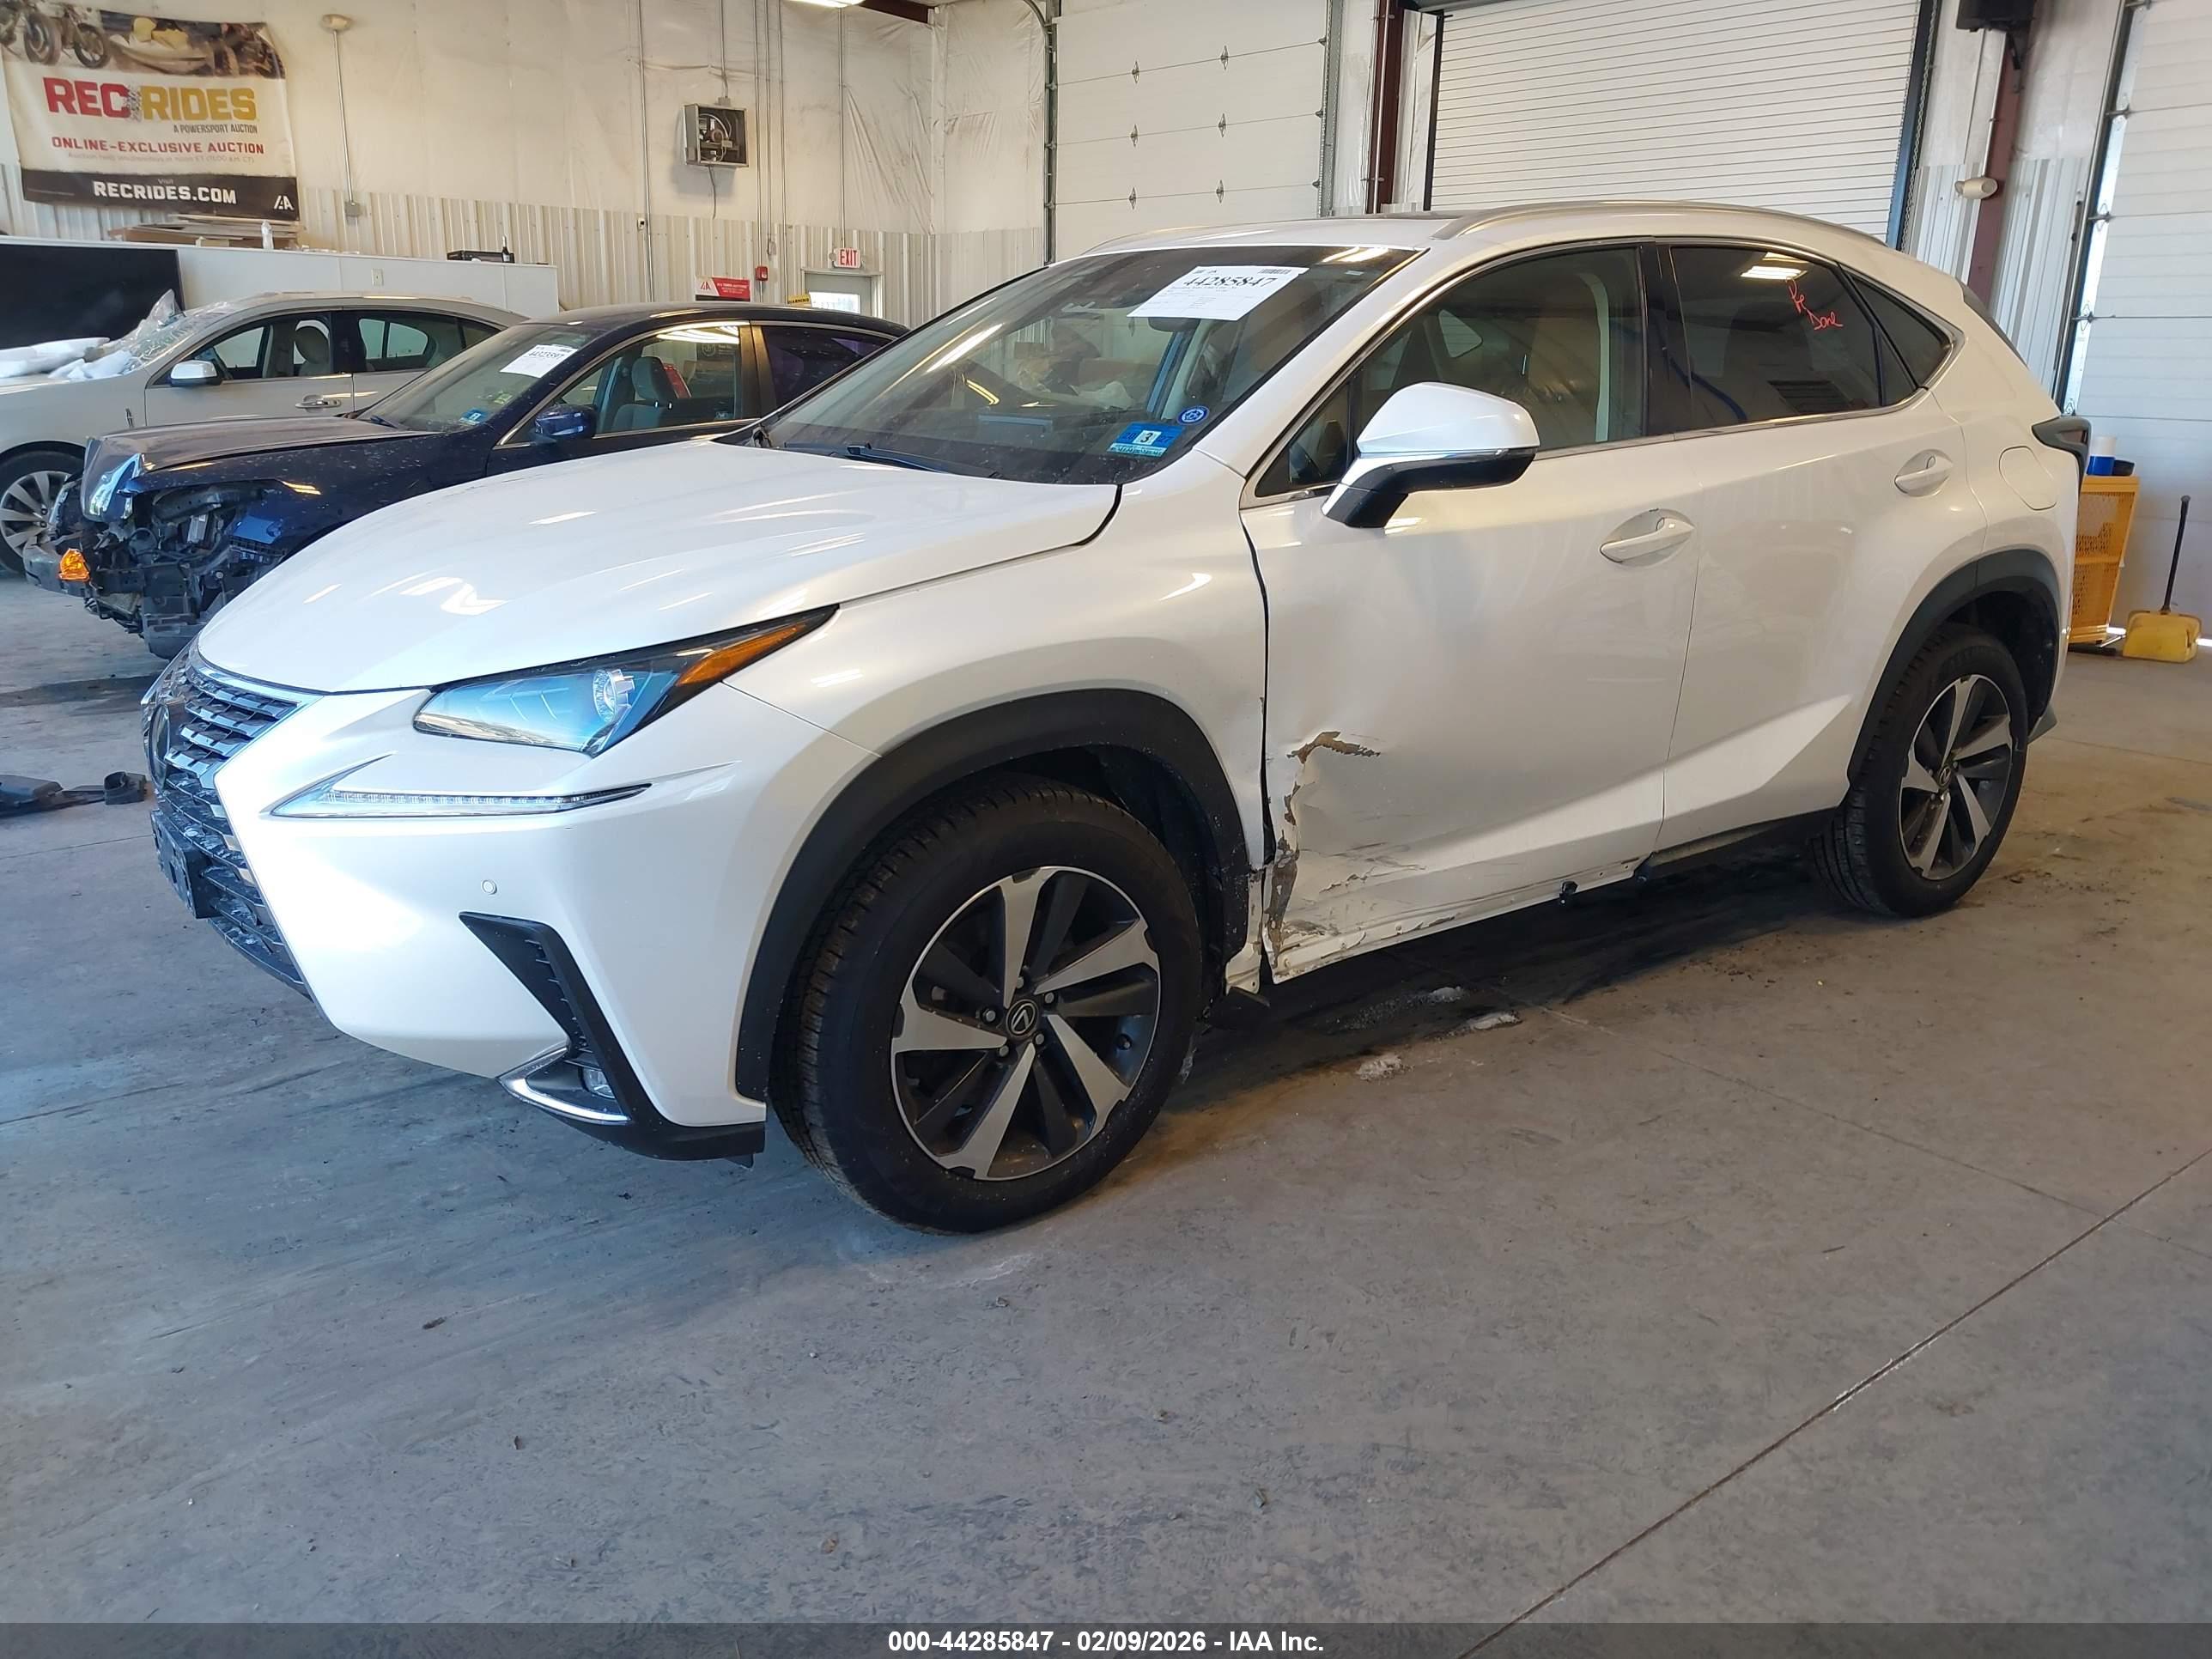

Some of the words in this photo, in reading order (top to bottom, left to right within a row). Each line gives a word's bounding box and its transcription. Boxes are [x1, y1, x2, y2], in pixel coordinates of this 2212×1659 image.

[141, 85, 257, 120] RIDES
[173, 125, 179, 133] A
[180, 125, 228, 133] POWERSPORT
[230, 124, 258, 133] AUCTION
[52, 137, 203, 153] ONLINE-EXCLUSIVE
[208, 142, 264, 155] AUCTION
[93, 181, 237, 204] RECRIDES.COM
[840, 249, 858, 266] EXIT
[1183, 276, 1279, 289] 44285847
[1140, 432, 1154, 443] 3
